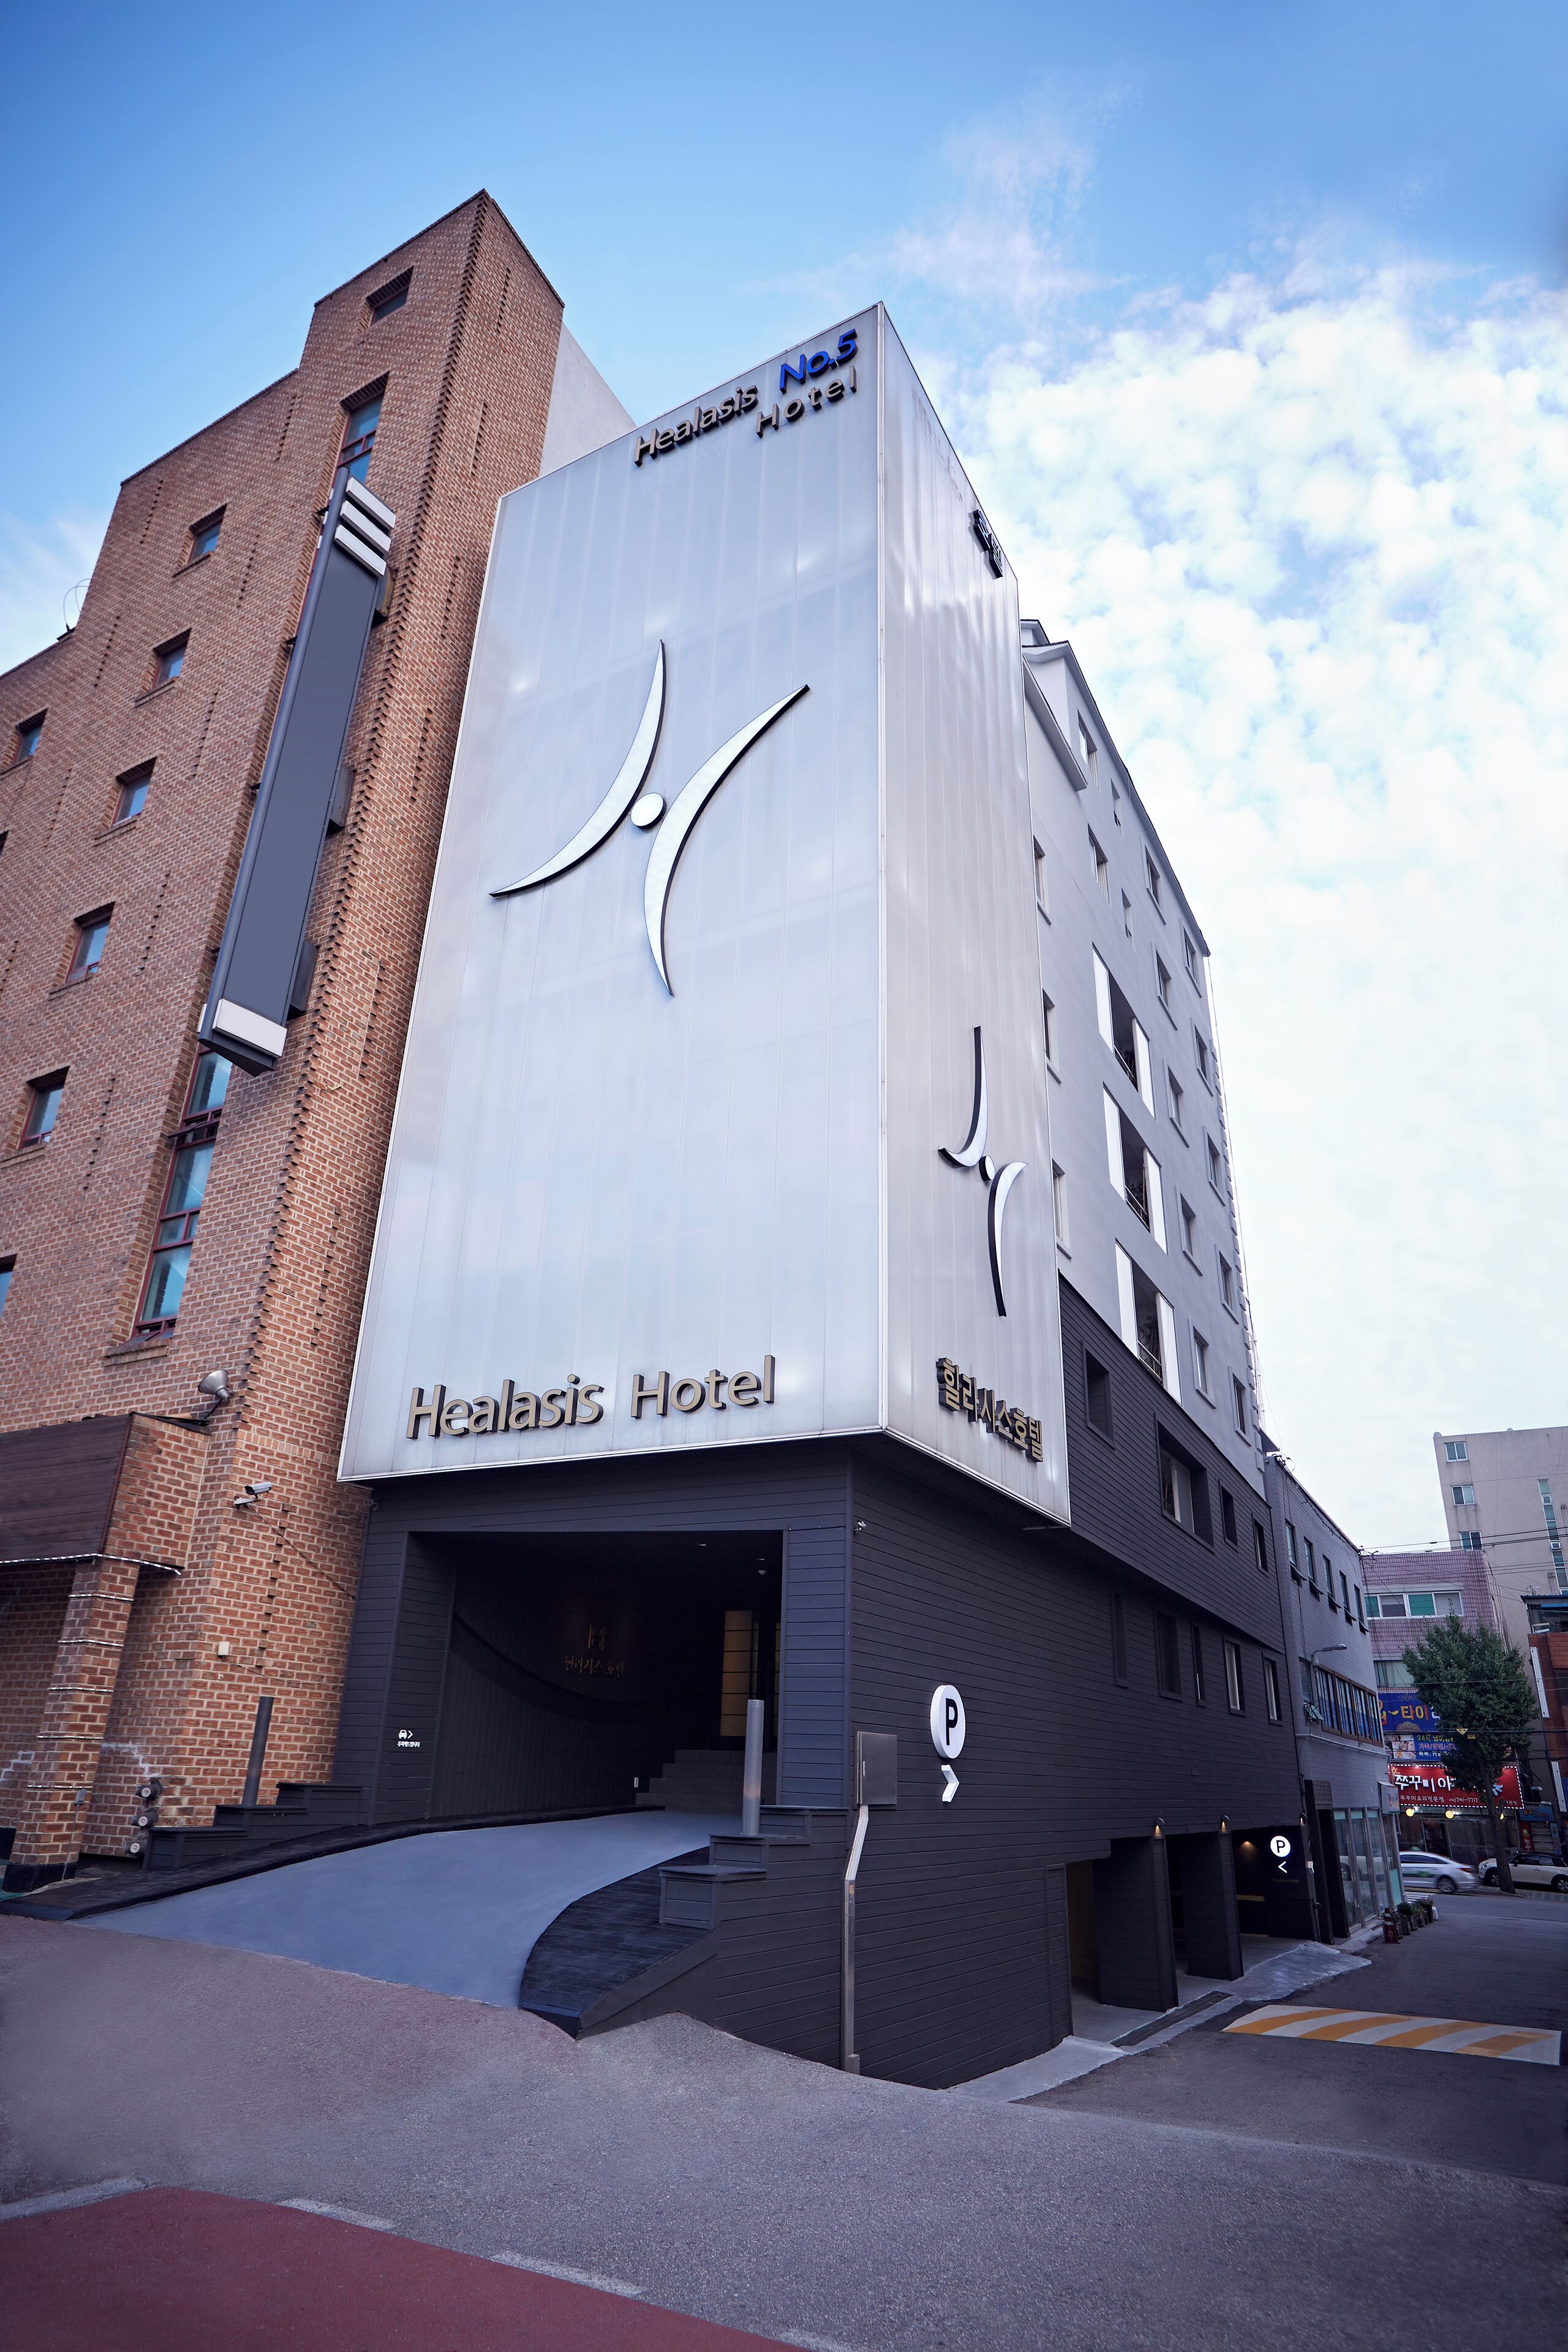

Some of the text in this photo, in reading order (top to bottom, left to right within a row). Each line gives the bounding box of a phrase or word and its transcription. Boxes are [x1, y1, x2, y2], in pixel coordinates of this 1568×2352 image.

[634, 385, 758, 467] Healasis
[779, 328, 858, 394] No.5
[756, 365, 857, 439] Hotel
[405, 1354, 776, 1439] Healasis Hotel
[935, 1357, 1043, 1462] 힐라시스호텔
[945, 1697, 959, 1746] P
[1395, 1774, 1435, 1793] 쭈꾸미
[1276, 1840, 1286, 1853] P
